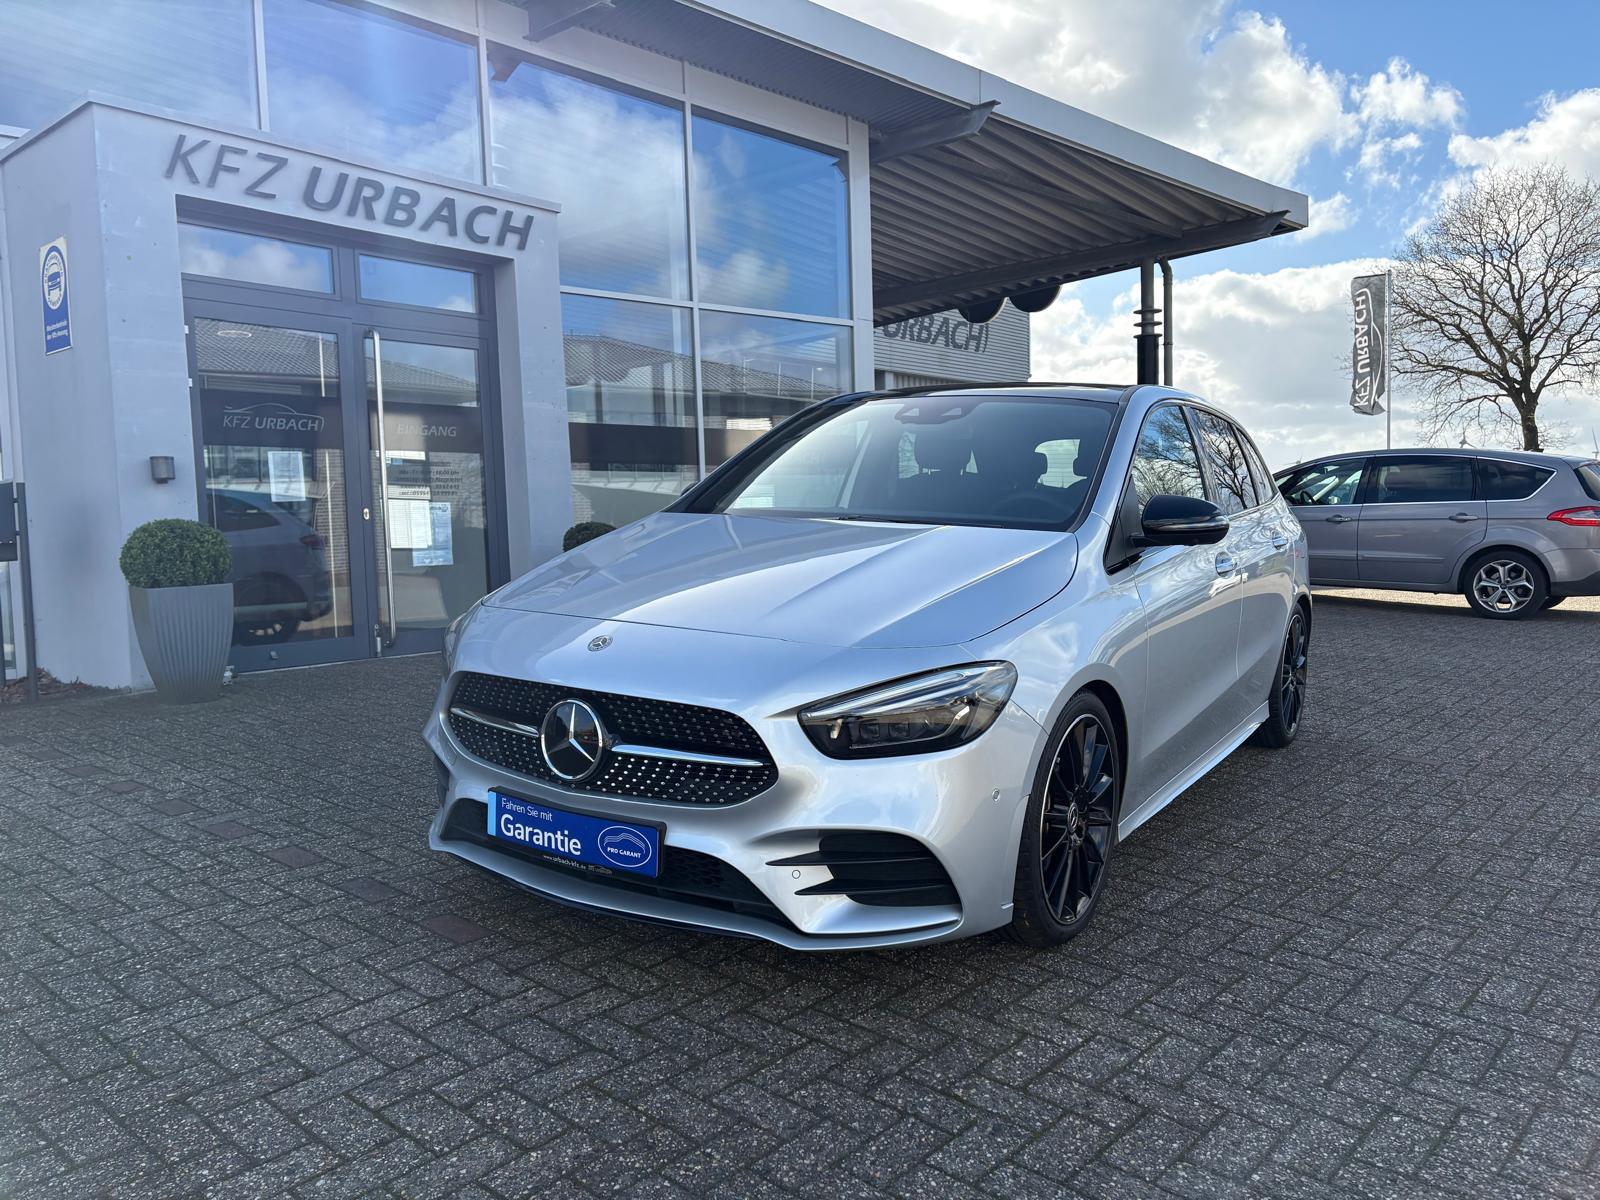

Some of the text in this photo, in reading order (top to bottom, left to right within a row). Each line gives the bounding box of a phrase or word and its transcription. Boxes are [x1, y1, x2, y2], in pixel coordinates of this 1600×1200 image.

[165, 134, 534, 251] KFZ URBACH
[223, 415, 319, 432] KFZ URBACH
[397, 423, 457, 438] EINGANG
[501, 797, 553, 822] Fahren Sie mit
[500, 814, 582, 856] Garantie
[607, 846, 642, 859] PRO GARANT
